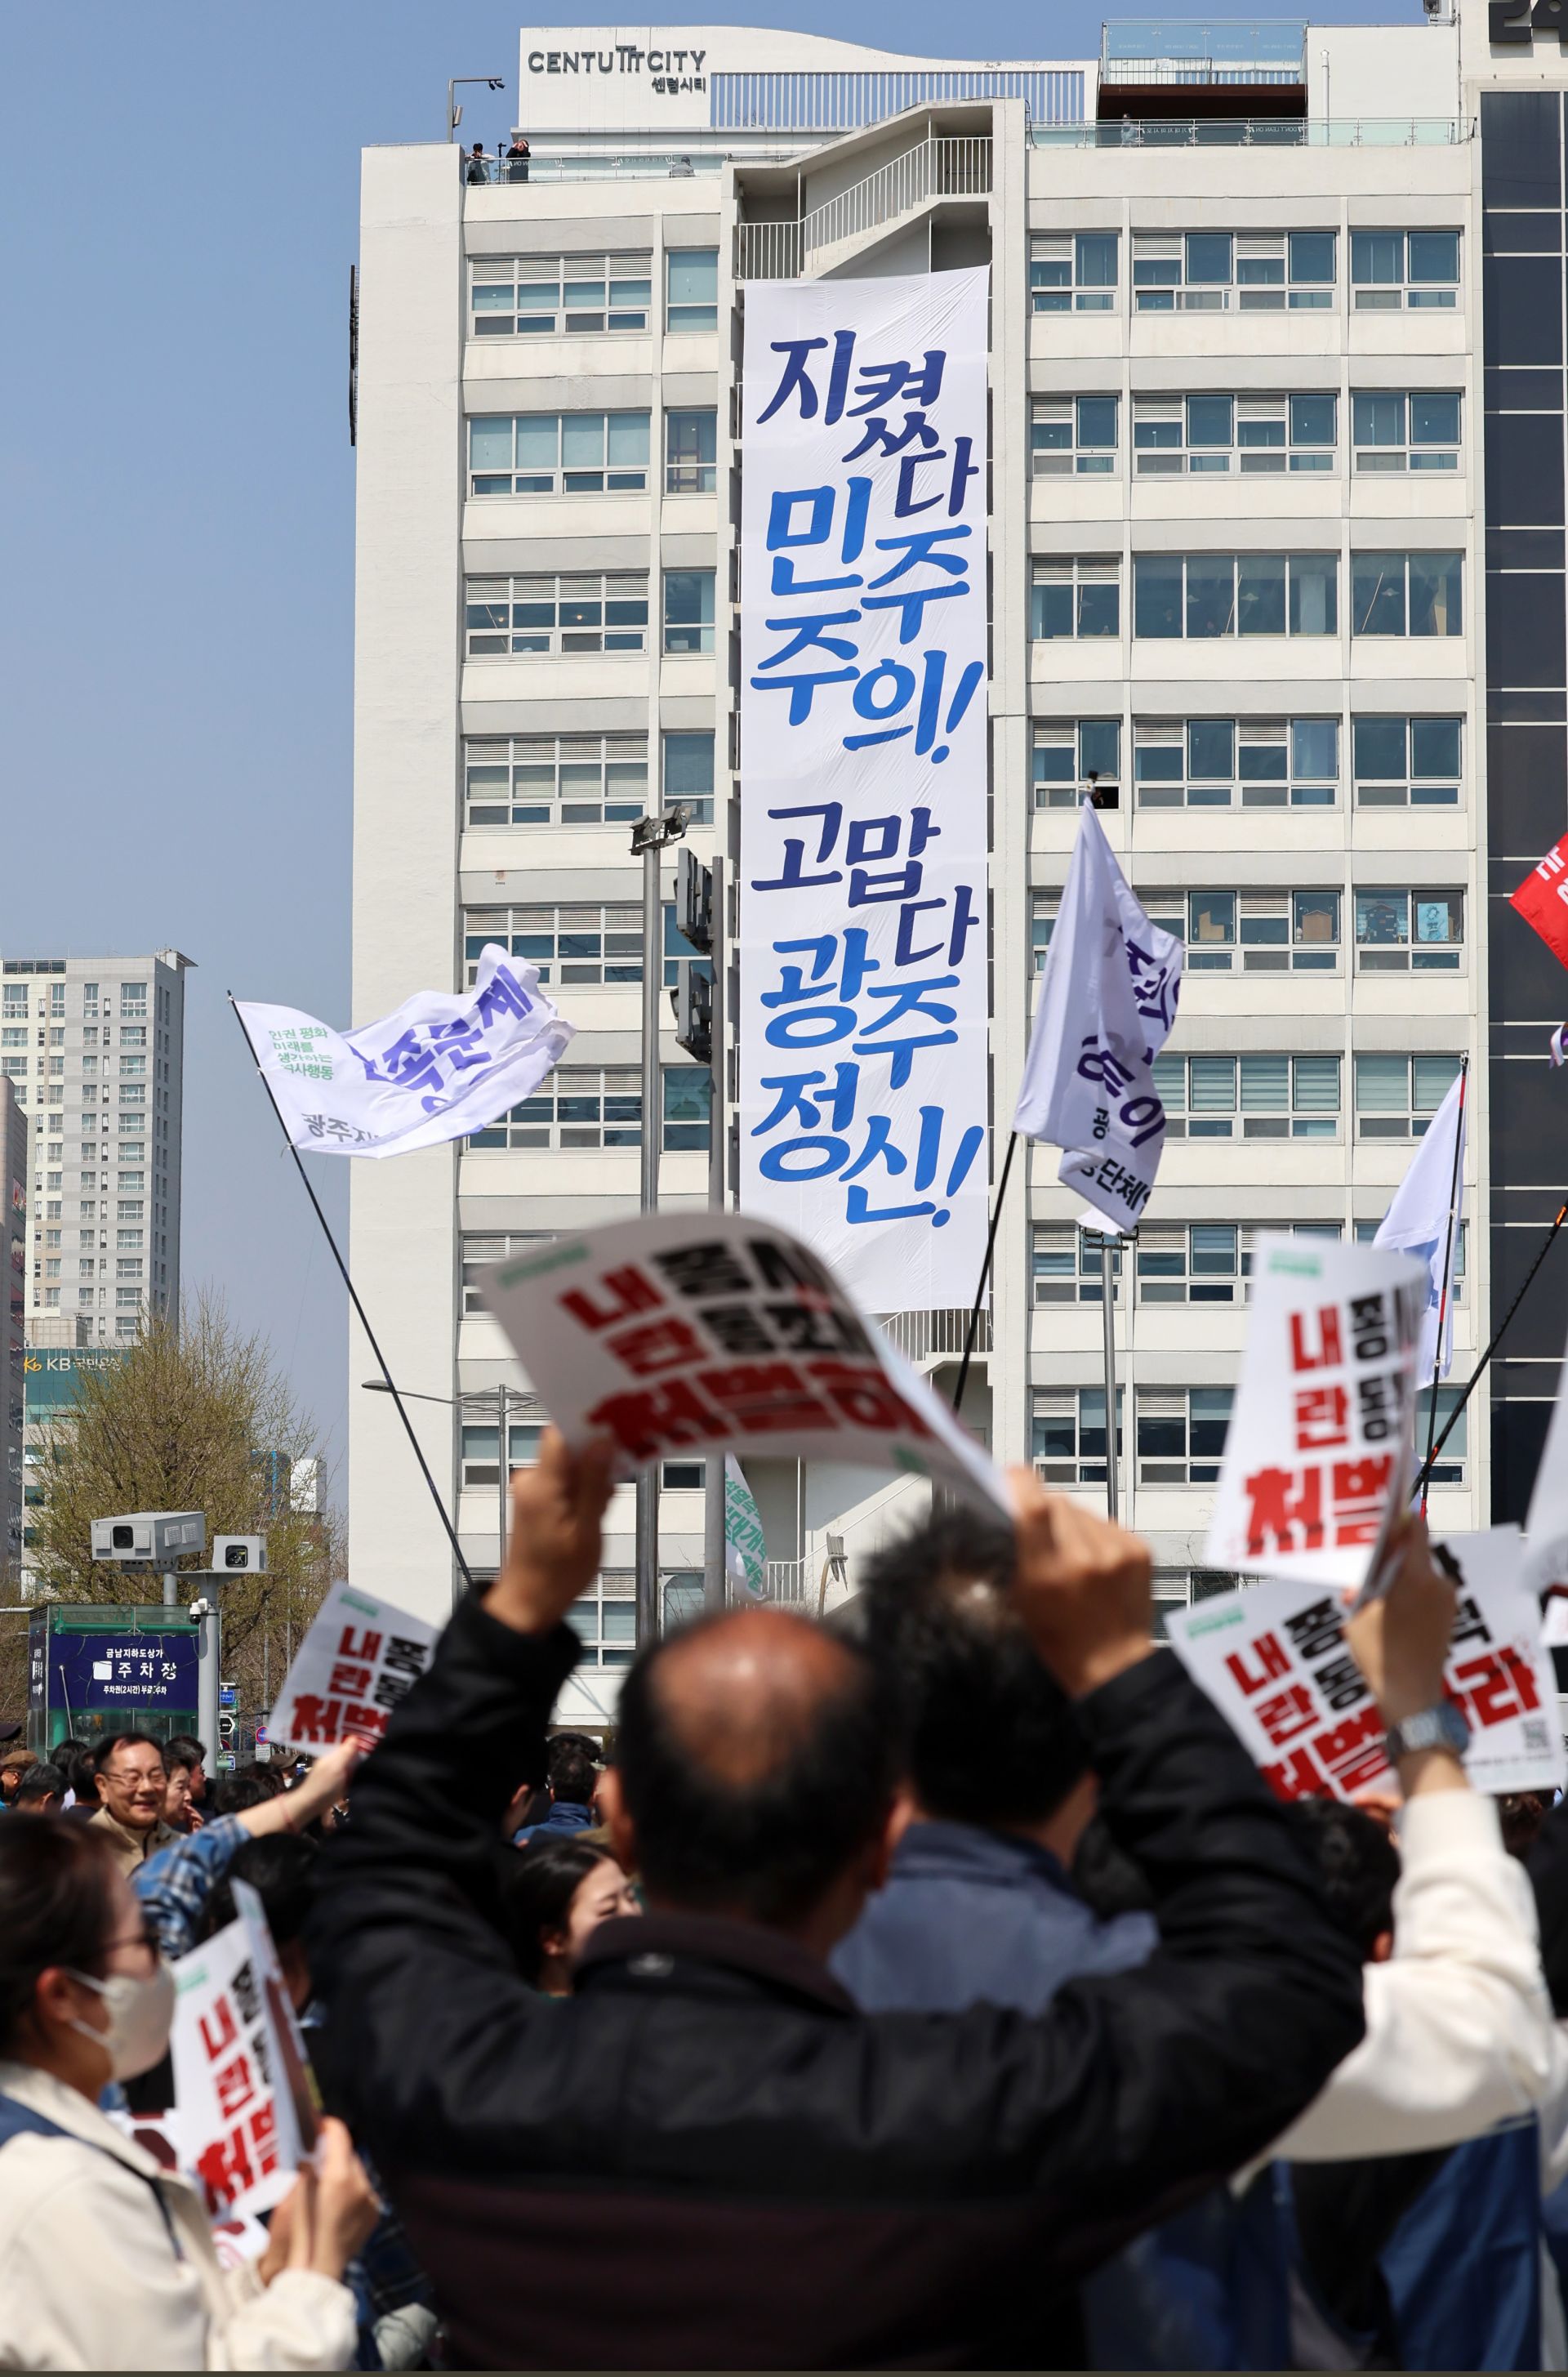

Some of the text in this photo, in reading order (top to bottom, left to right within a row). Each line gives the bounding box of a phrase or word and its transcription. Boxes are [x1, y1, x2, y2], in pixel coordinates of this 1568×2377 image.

[652, 77, 706, 93] 센텀시티
[756, 330, 979, 518] 지켰다
[751, 801, 979, 966] 고맙다
[268, 1027, 327, 1040] 인권 평화
[273, 1041, 314, 1053] 미래를
[301, 1113, 378, 1142] 광주지
[47, 1358, 71, 1371] KB
[585, 1362, 933, 1461] 처벌하
[106, 1648, 163, 1658] 금남지하도상가
[103, 1685, 140, 1694] 주차권(2시간)
